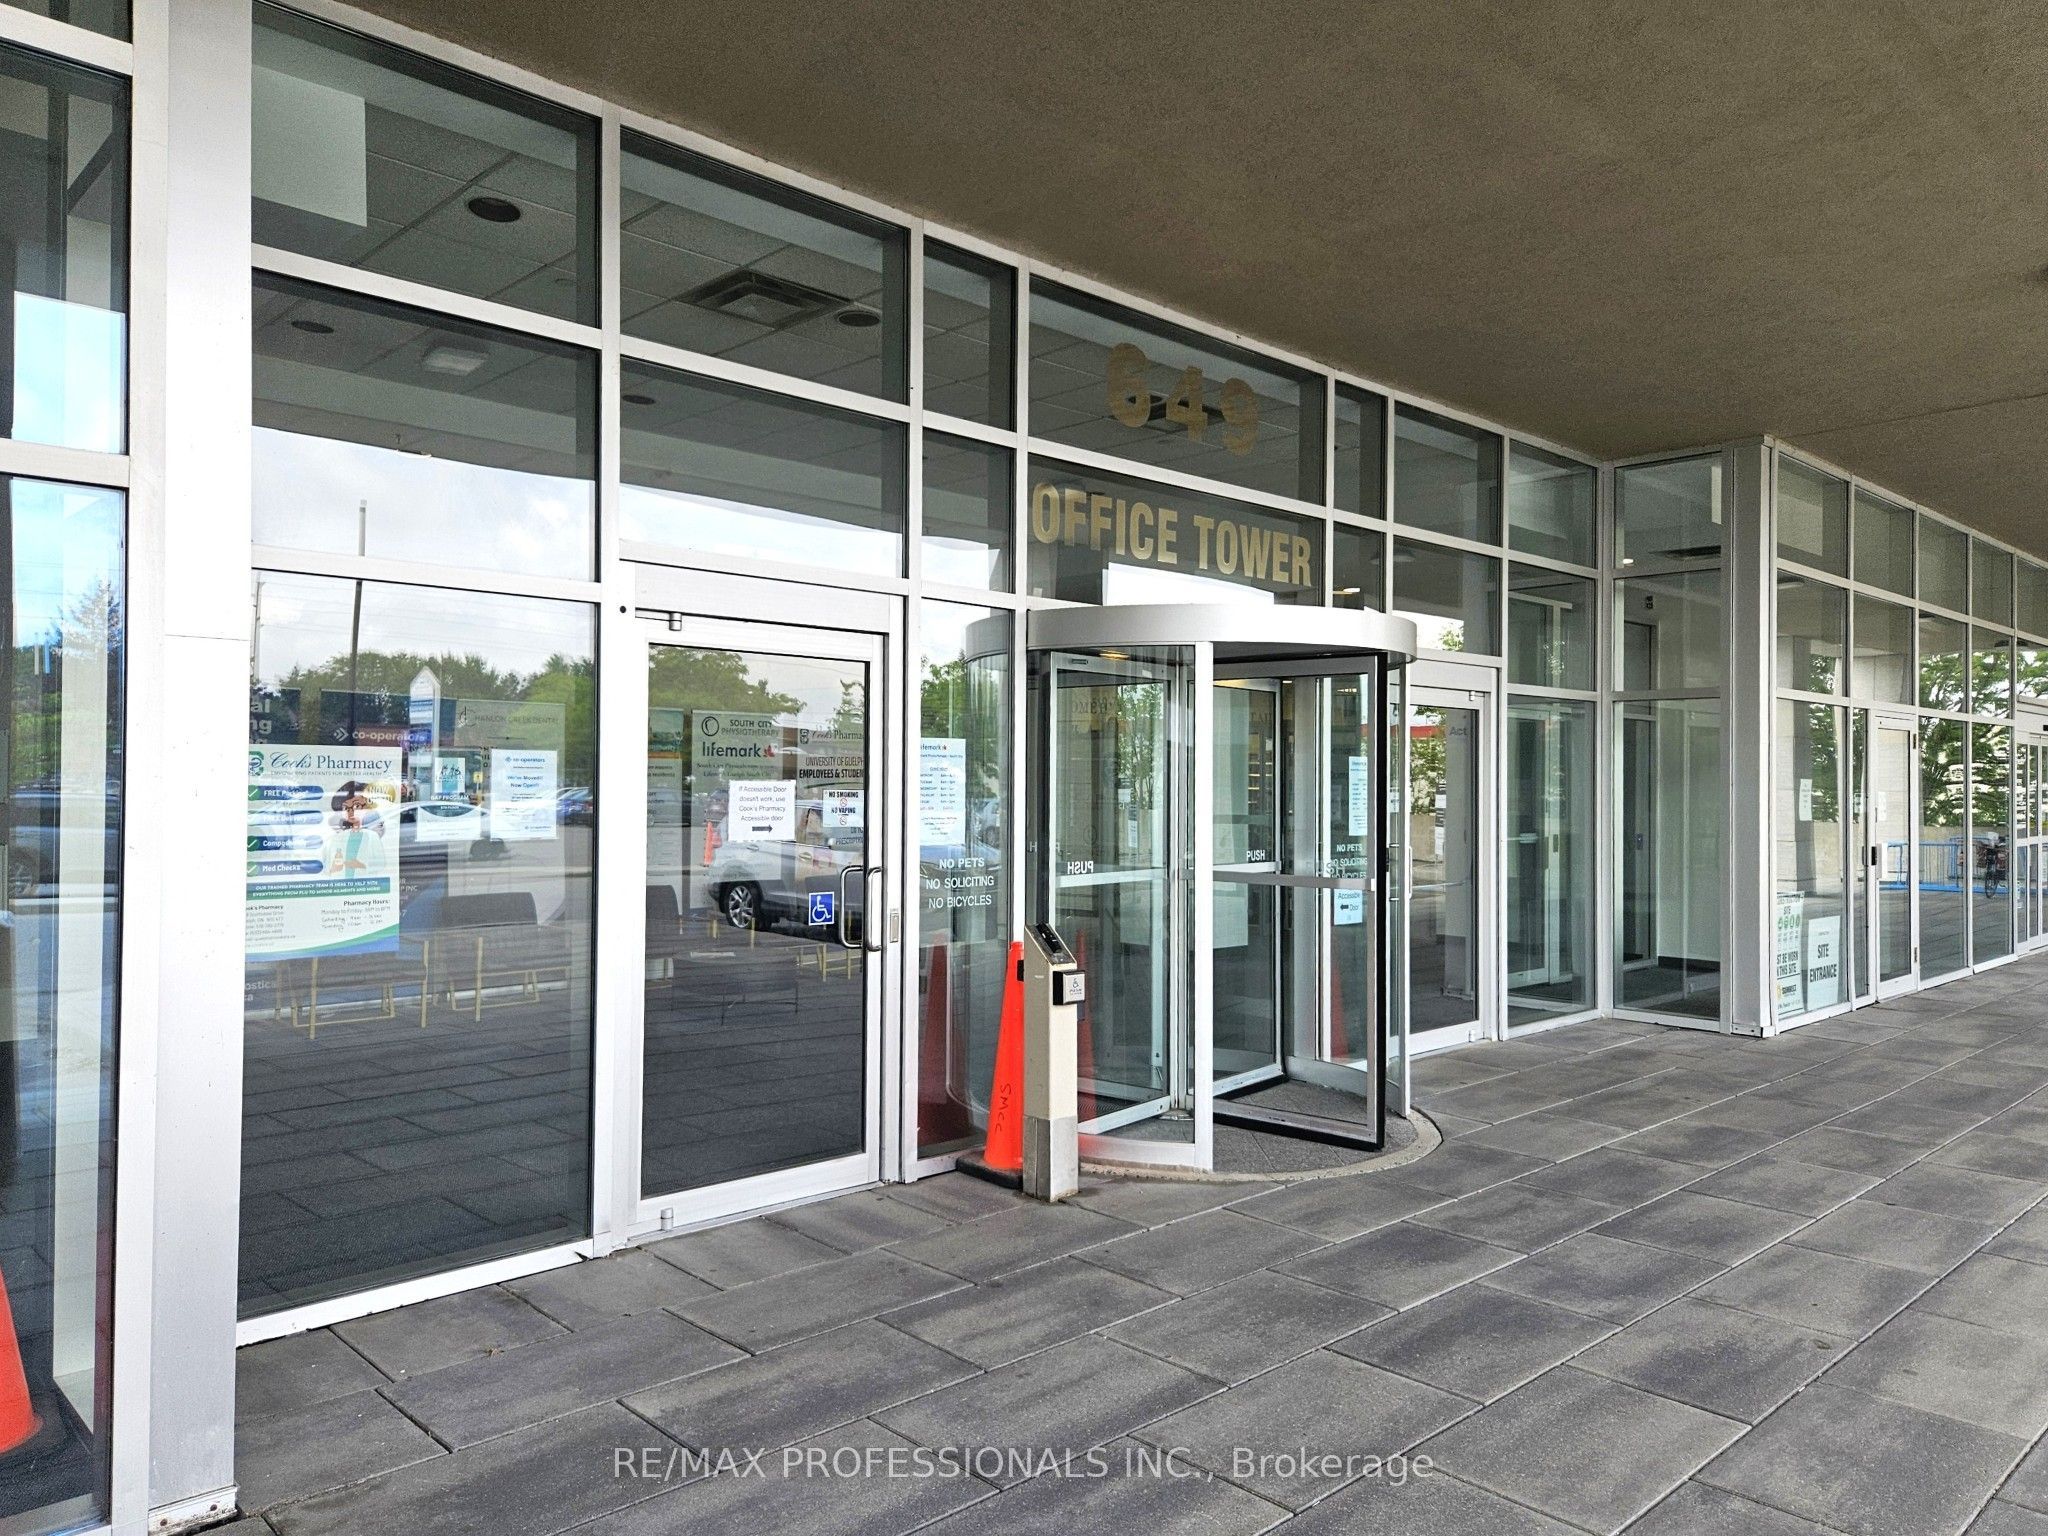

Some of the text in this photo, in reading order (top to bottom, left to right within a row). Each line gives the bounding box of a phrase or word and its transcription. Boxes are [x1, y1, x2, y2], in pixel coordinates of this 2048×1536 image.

[1031, 482, 1312, 587] OFFICE TOWER
[729, 719, 773, 729] SOUTH CITY
[702, 741, 762, 758] lifemark
[316, 754, 393, 773] Pharmacy
[805, 756, 836, 767] UNIVERSITY
[836, 756, 844, 767] OF
[799, 768, 834, 779] EMPLOYEES
[834, 768, 840, 778] &
[1336, 843, 1363, 852] NO PETS
[1246, 849, 1266, 862] PUSH
[262, 864, 276, 872] Med
[939, 857, 985, 869] NO PETS
[926, 875, 994, 890] NO SOLICITING
[928, 895, 992, 909] NO BICYCLES
[1817, 943, 1830, 959] SITE
[1809, 963, 1838, 983] ENTRANCE
